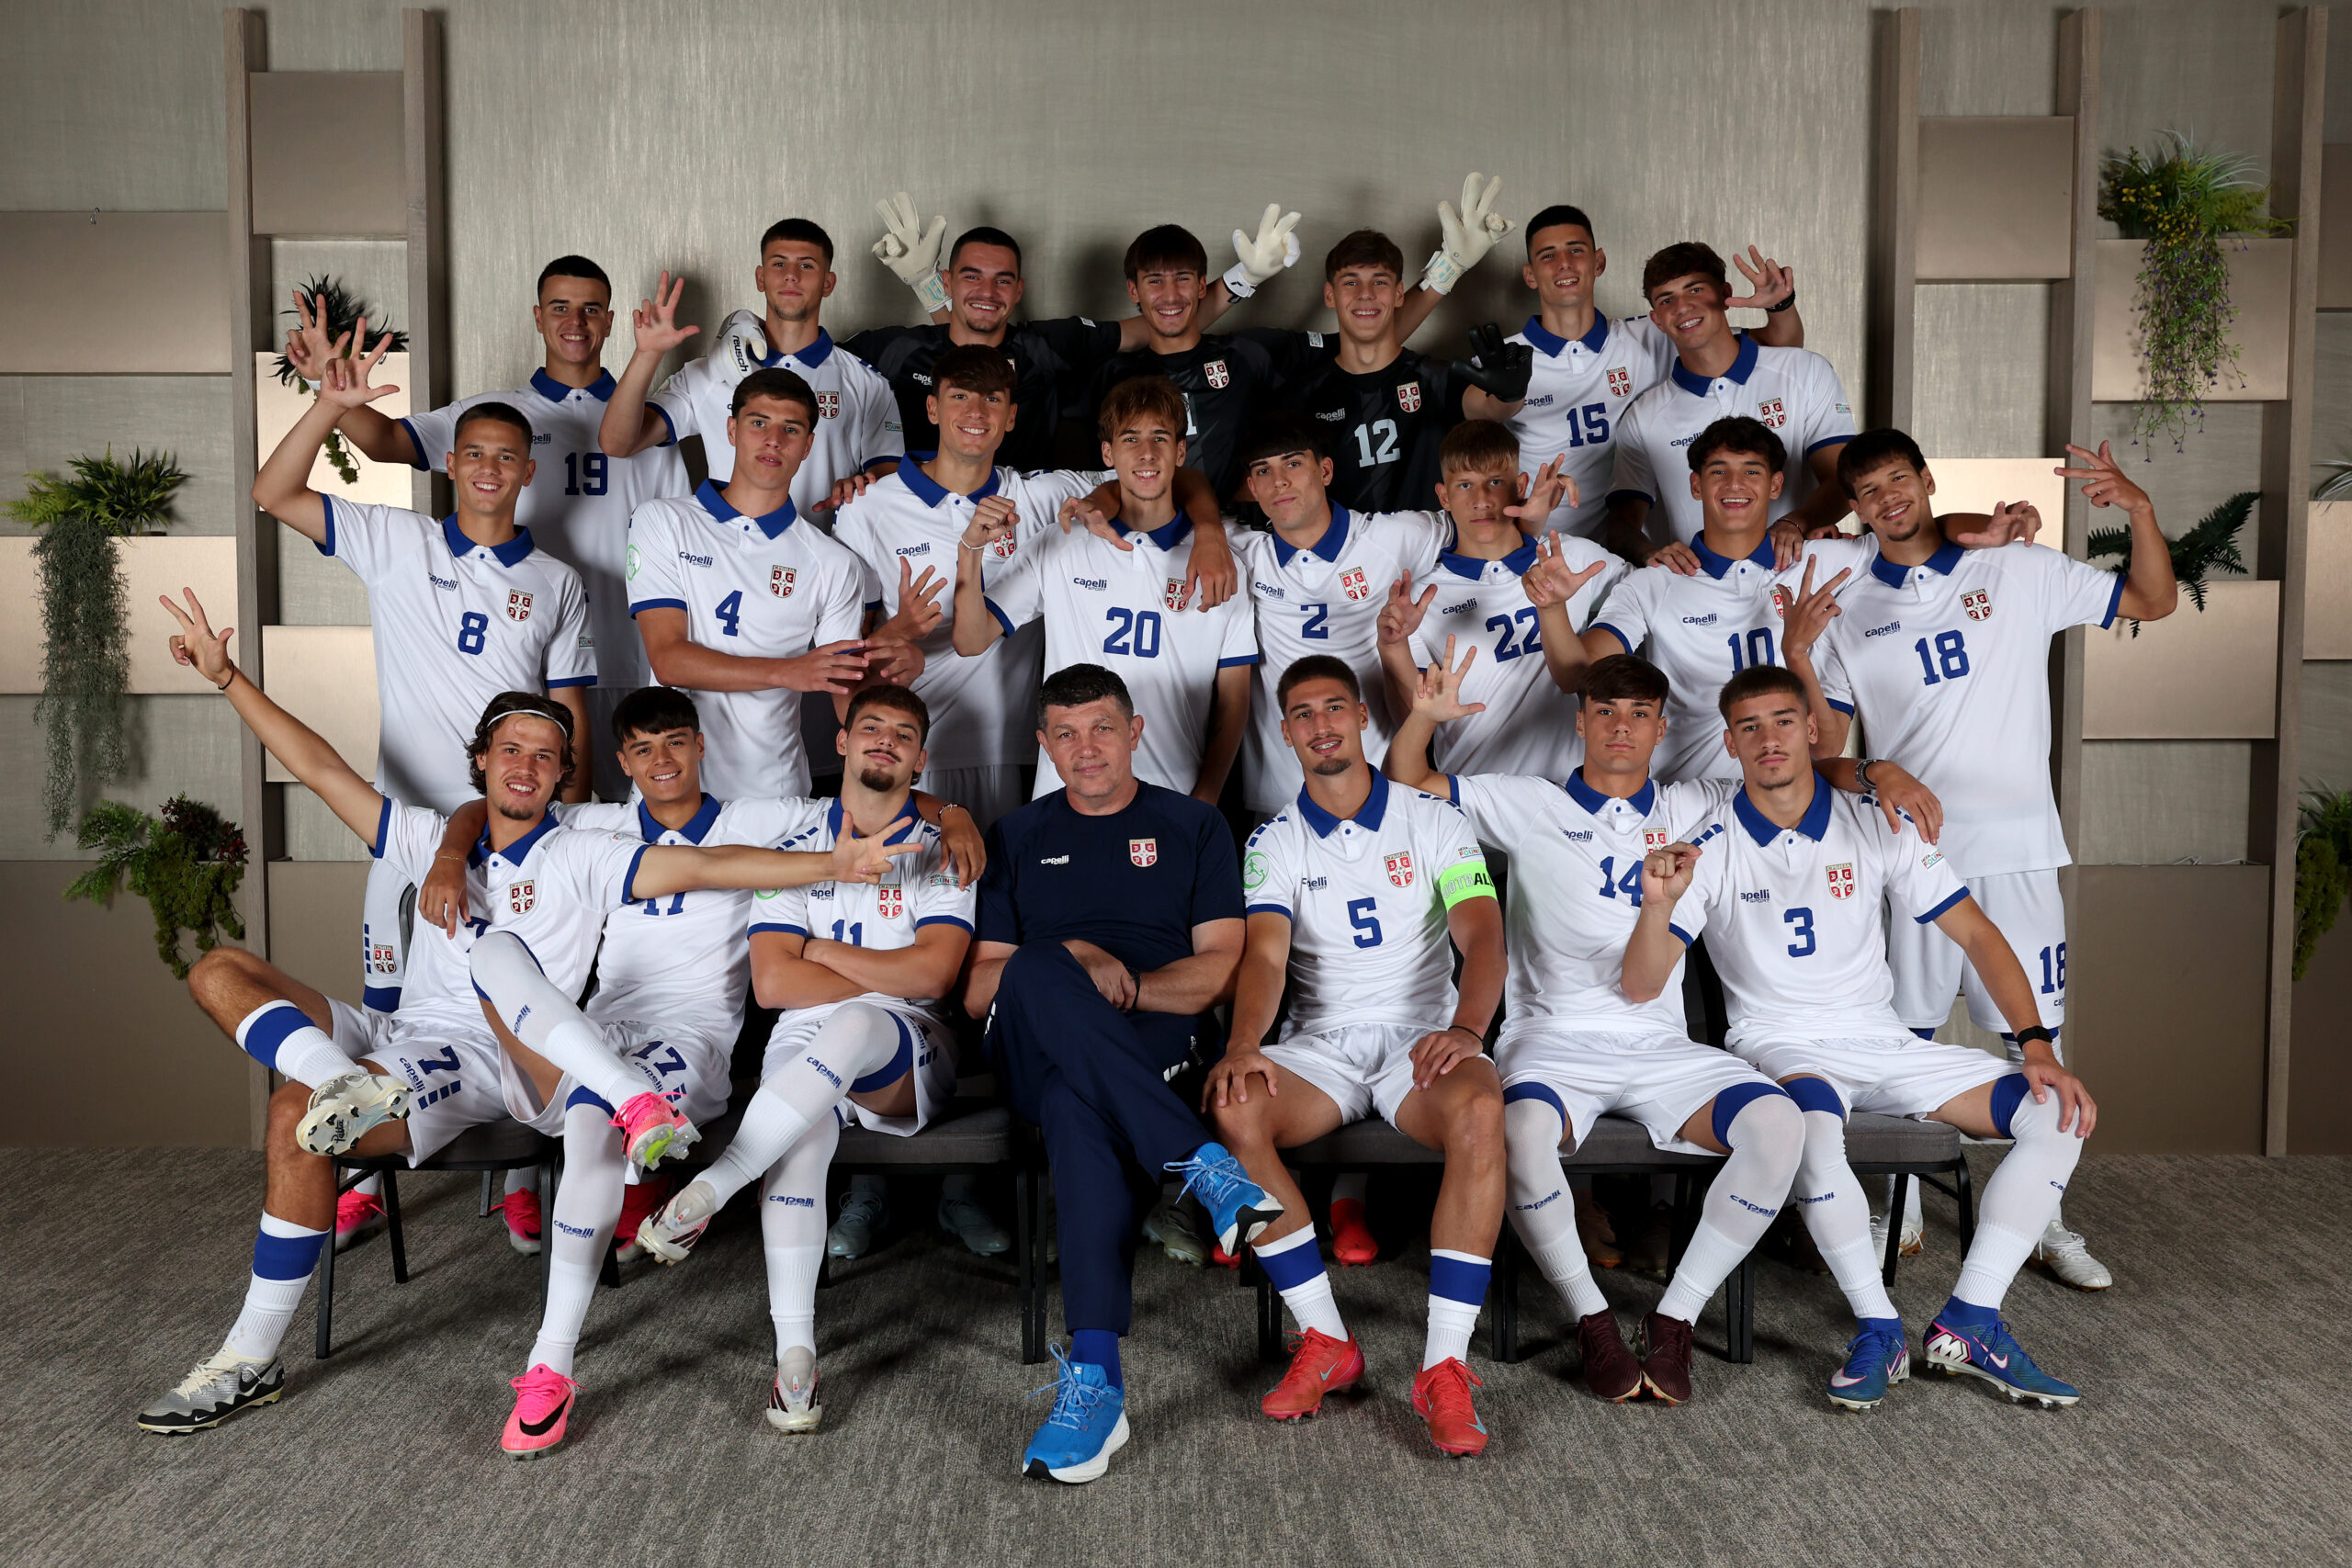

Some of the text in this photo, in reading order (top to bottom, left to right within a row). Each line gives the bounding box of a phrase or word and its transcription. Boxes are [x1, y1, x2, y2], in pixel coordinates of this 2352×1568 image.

[732, 334, 749, 372] reusch
[913, 373, 933, 384] cape
[1316, 408, 1345, 421] capelli
[1566, 402, 1610, 447] 15
[532, 434, 551, 445] pelli
[1353, 419, 1401, 468] 12
[1670, 432, 1702, 446] capelli
[565, 452, 608, 496] 19
[679, 551, 714, 566] capelli
[896, 542, 930, 557] capelli
[1073, 577, 1107, 589] capelli
[1254, 581, 1285, 599] capelli
[715, 590, 743, 637] 4
[1442, 598, 1477, 615] capelli
[1682, 614, 1717, 625] capelli
[458, 611, 489, 655] 8
[1102, 606, 1161, 659] 20
[1300, 604, 1329, 639] 2
[1485, 605, 1544, 663] 22
[1865, 621, 1900, 637] capelli
[1727, 626, 1777, 677] 10
[1914, 629, 1970, 686] 18
[1558, 828, 1593, 840] apelli
[1041, 855, 1069, 865] capelli
[811, 887, 834, 899] apel
[930, 876, 959, 885] FOUNDA
[1301, 876, 1327, 888] celli
[1599, 856, 1645, 908] 14
[1740, 889, 1770, 902] apelli
[831, 919, 862, 948] 11
[1346, 897, 1383, 949] 5
[1783, 907, 1816, 958] 3
[2040, 942, 2066, 994] 18
[418, 1045, 461, 1076] 7
[632, 1041, 687, 1077] 17
[399, 1057, 425, 1093] capelli
[634, 1062, 663, 1092] capelli
[807, 1056, 842, 1089] capelli
[769, 1195, 815, 1207] capelli
[1514, 1190, 1562, 1211] capelli
[1730, 1194, 1778, 1217] capelli
[553, 1220, 595, 1236] capelli
